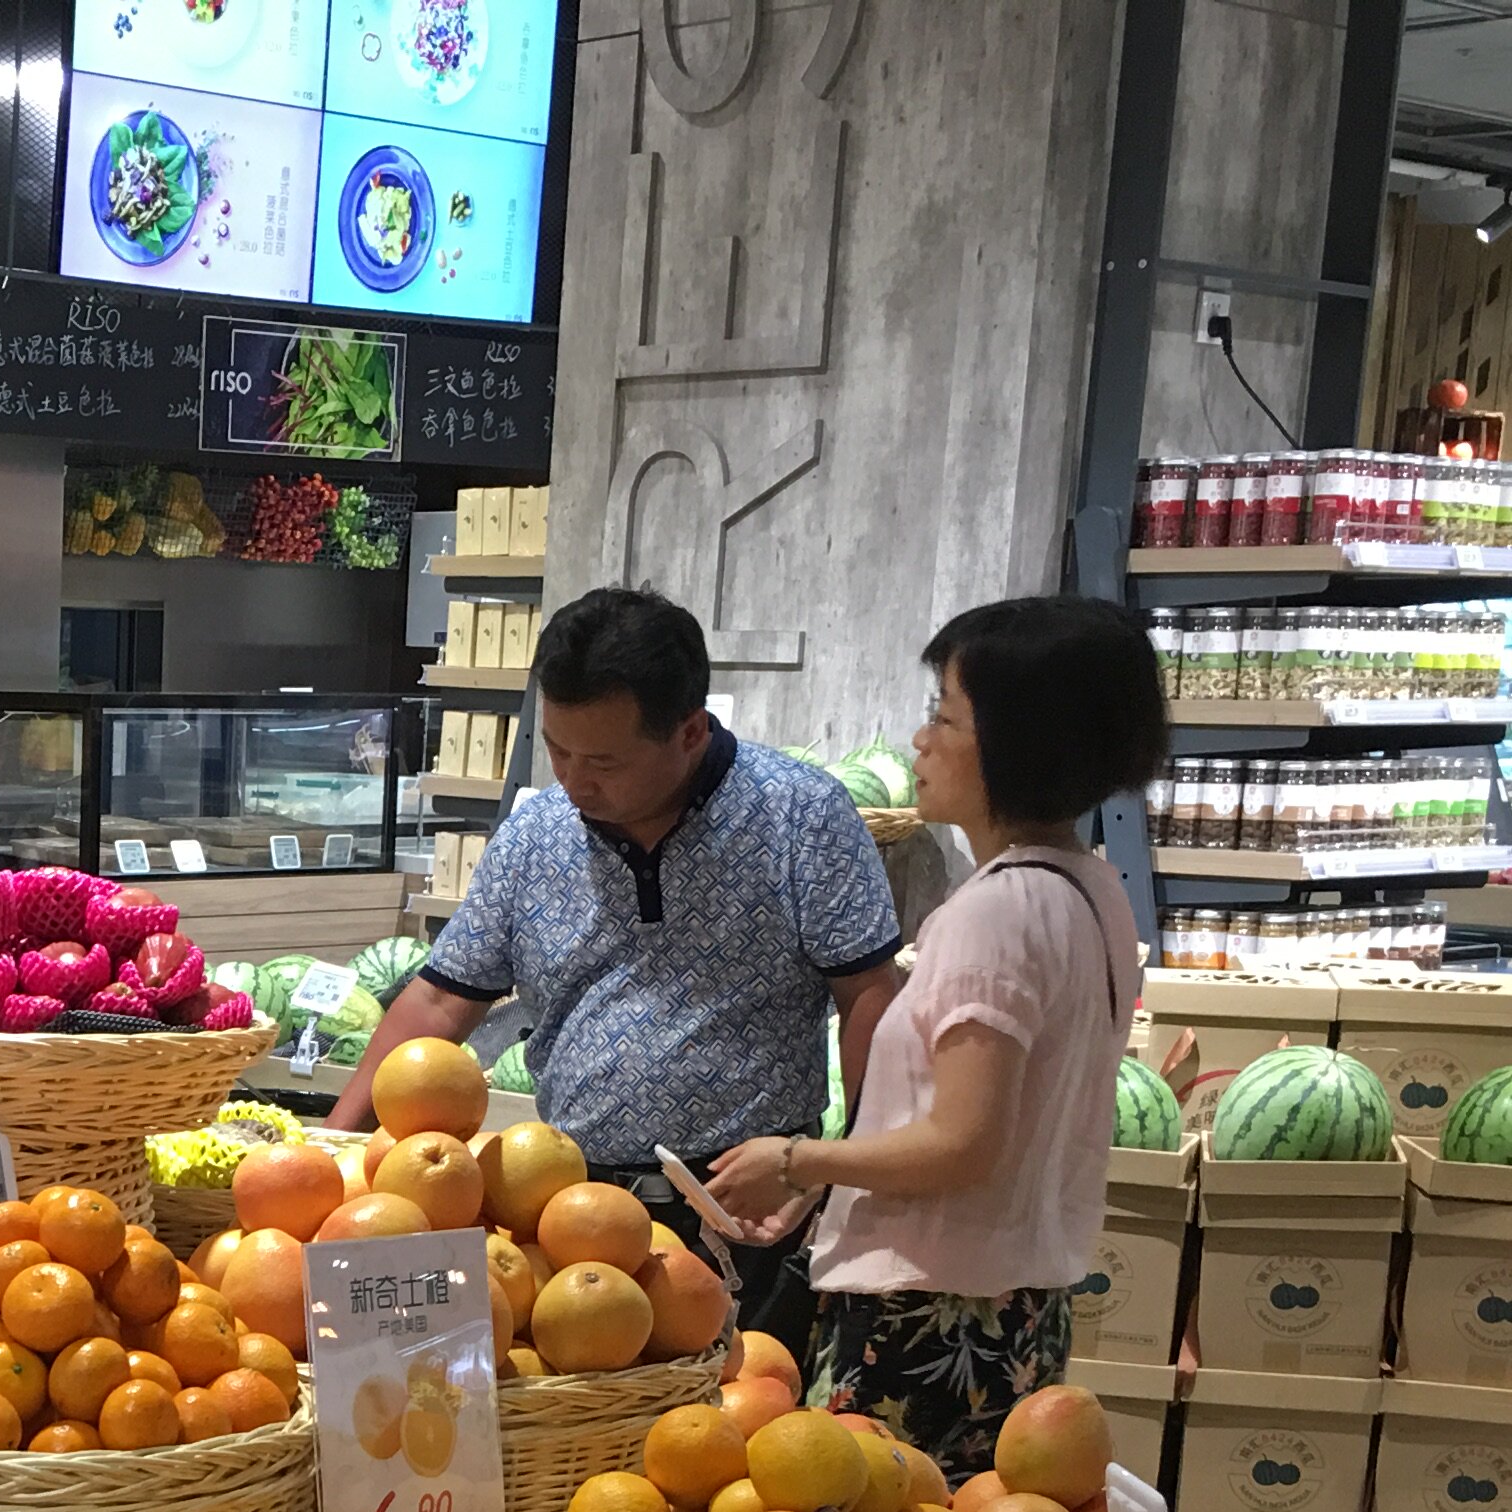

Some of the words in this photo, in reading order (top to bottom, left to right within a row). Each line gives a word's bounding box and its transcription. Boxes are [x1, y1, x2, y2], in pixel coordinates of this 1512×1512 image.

[210, 369, 253, 395] riso
[348, 1269, 451, 1315] 新奇士橙
